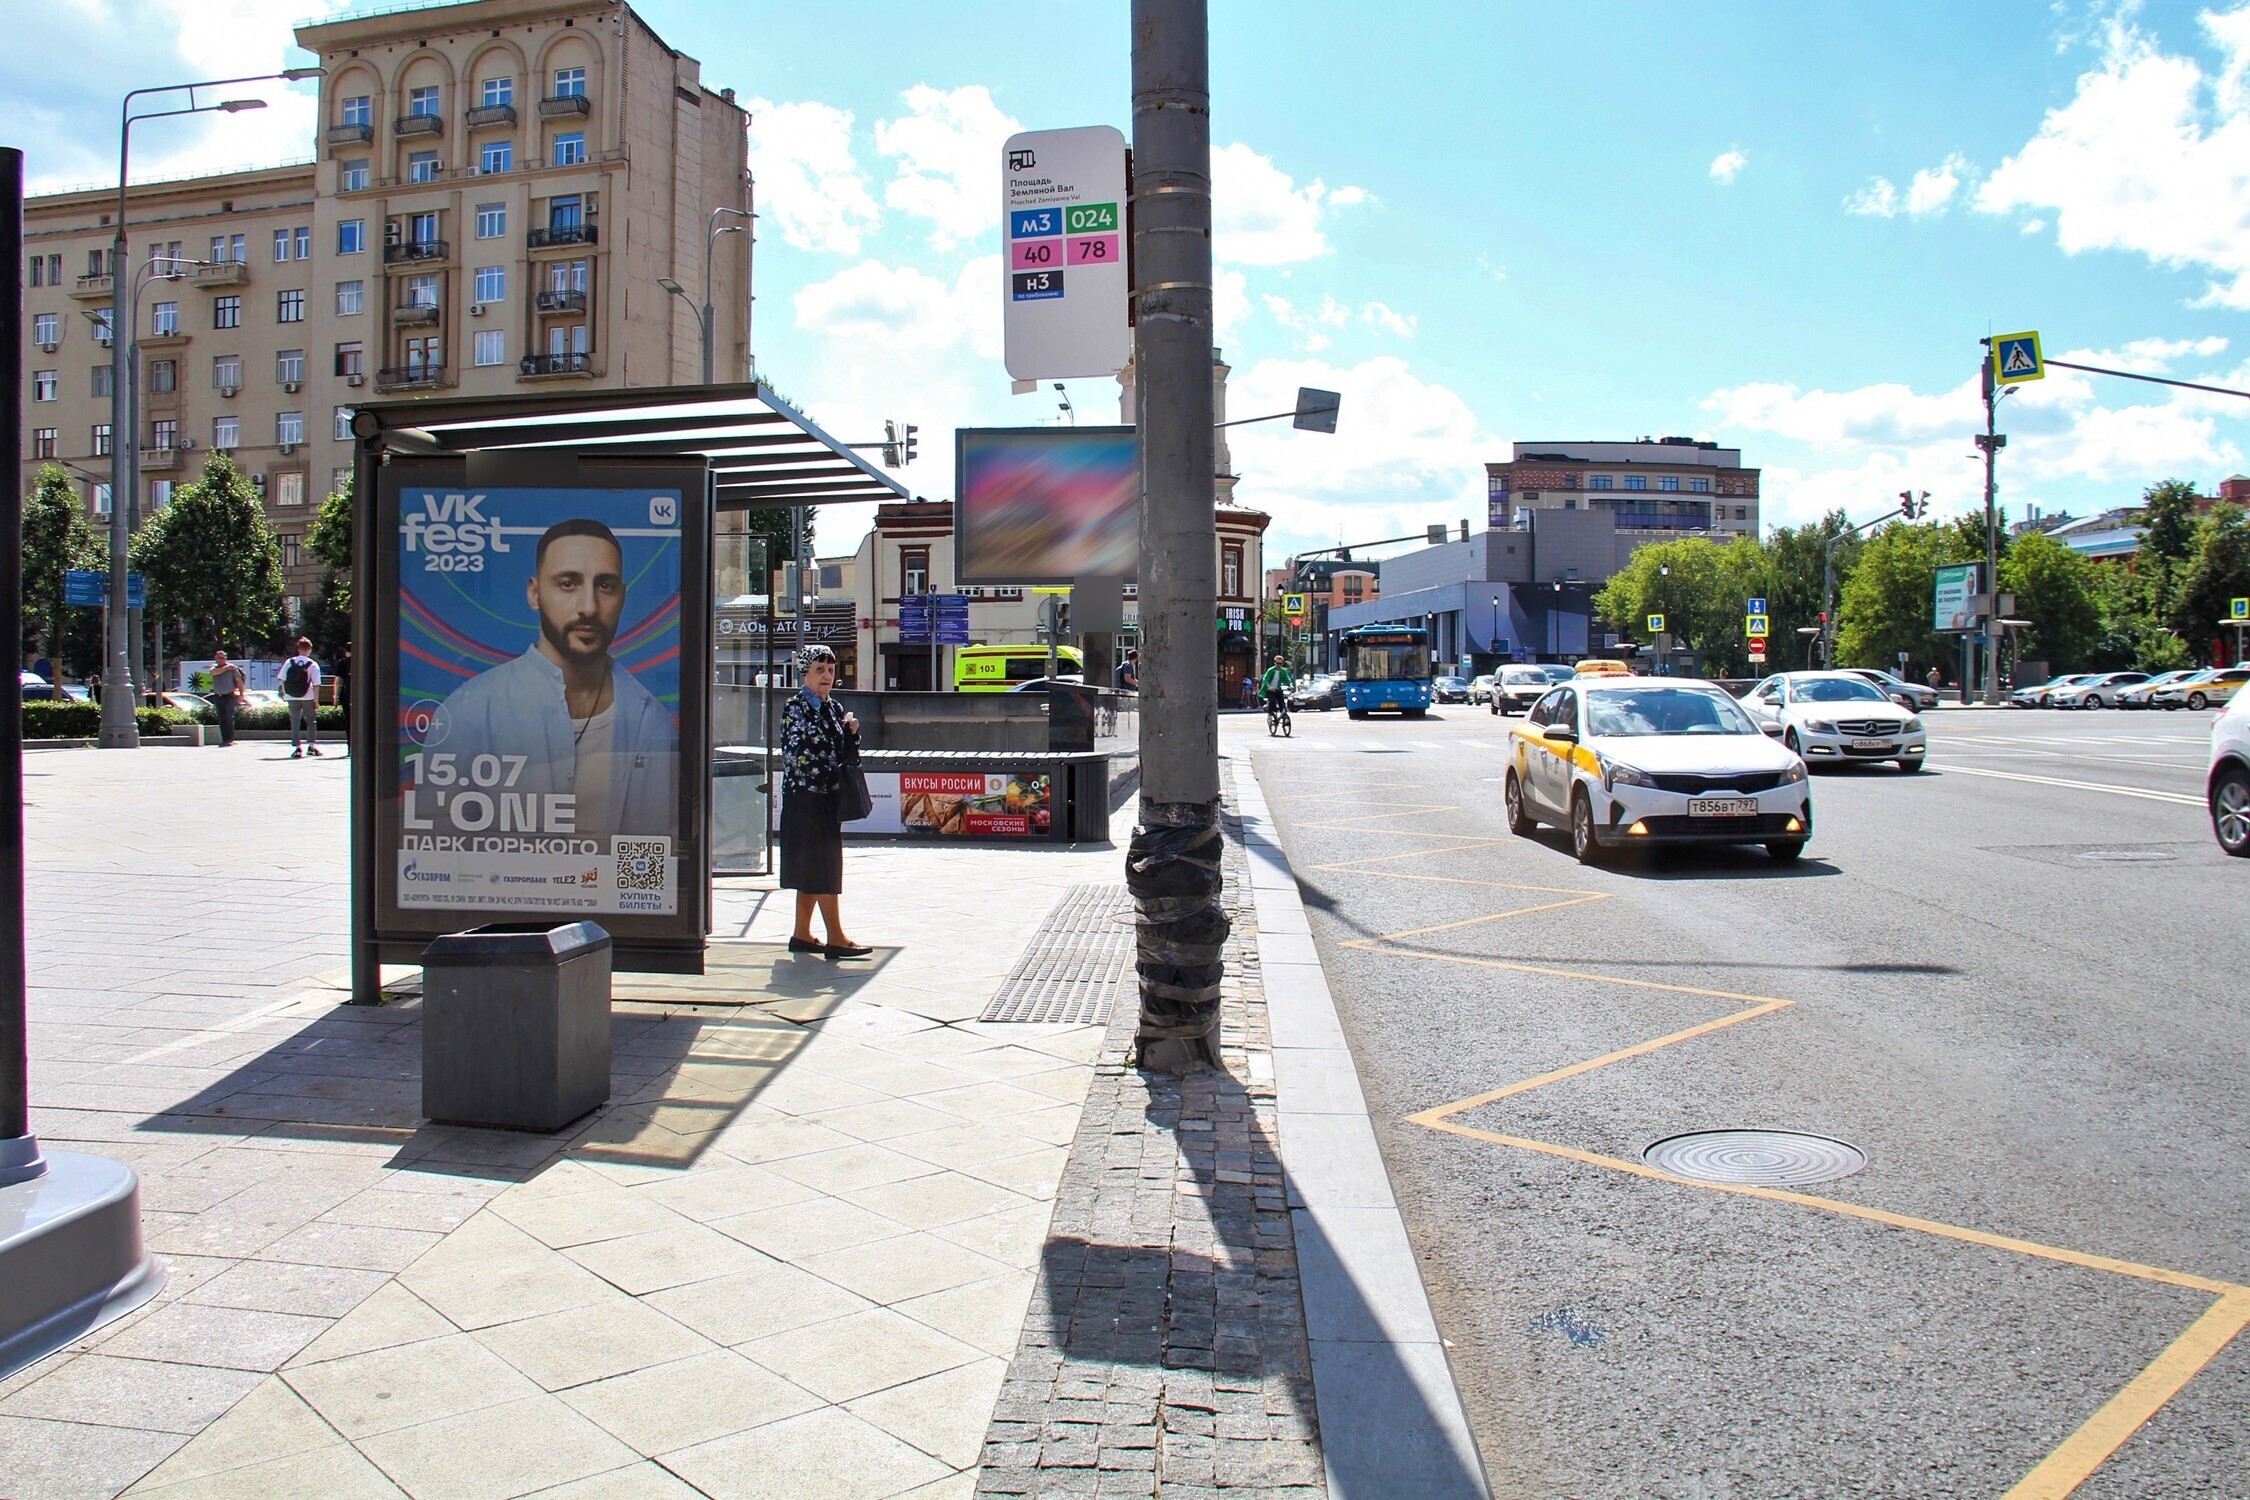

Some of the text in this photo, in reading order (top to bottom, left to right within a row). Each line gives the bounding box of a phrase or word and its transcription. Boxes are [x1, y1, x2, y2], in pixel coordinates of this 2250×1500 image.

[1010, 178, 1052, 187] Площадь
[1010, 184, 1074, 197] Земляной Вал
[1021, 213, 1051, 233] м3
[1071, 208, 1112, 229] 024
[1024, 245, 1051, 263] 40
[1079, 240, 1106, 259] 78
[423, 494, 487, 522] VK
[400, 512, 510, 553] fest
[424, 554, 485, 572] 2023
[1225, 608, 1244, 619] IRISH
[1228, 620, 1242, 630] PUB
[979, 665, 996, 673] 103
[416, 713, 444, 733] 0+
[404, 752, 529, 787] 15.07
[904, 777, 981, 790] ВКУСЫ РОССИИ
[404, 789, 576, 834] L'ONE
[1692, 800, 1754, 812] Т856ВТ 797
[970, 819, 1025, 827] МОСКОВСКИЕ
[403, 834, 599, 856] ПАРК ГОРЬКОГО
[620, 892, 661, 901] КУПИТЬ
[619, 902, 662, 910] БИЛЕТЫ
